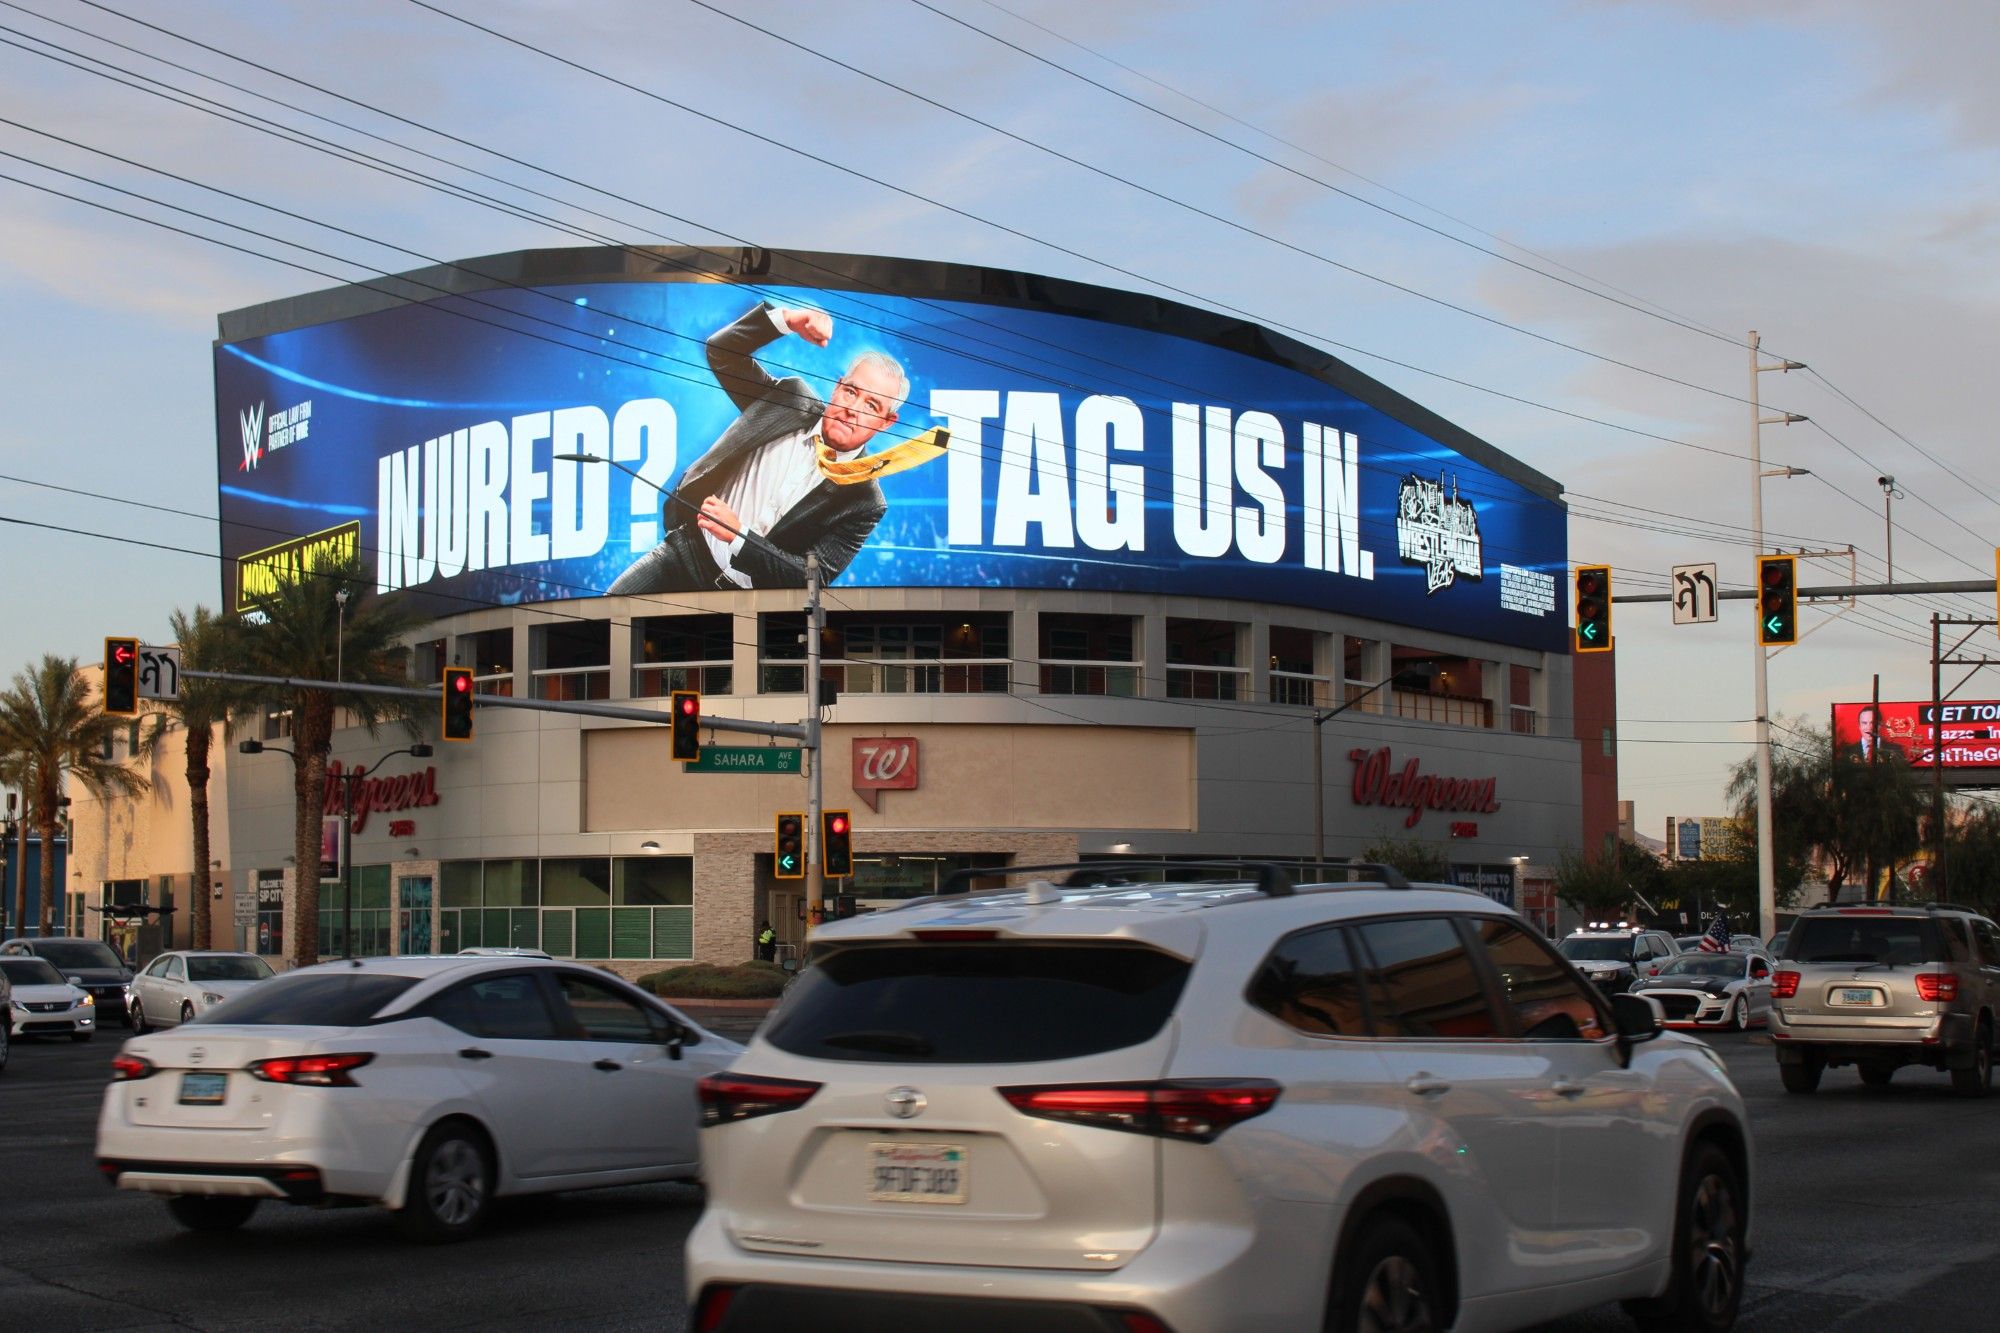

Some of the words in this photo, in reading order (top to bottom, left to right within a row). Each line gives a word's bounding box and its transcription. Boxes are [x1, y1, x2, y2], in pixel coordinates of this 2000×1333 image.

[378, 397, 678, 595] INJURED?
[929, 390, 1146, 552] TAG
[1171, 401, 1286, 564] US
[1302, 421, 1374, 581] IN.
[242, 551, 289, 602] MORGAN
[291, 548, 300, 586] &
[714, 753, 765, 766] SAHARA
[778, 751, 793, 760] AVE
[1348, 745, 1501, 829] Walgreens
[259, 889, 270, 903] SIP
[1458, 872, 1498, 885] WELCOME
[1498, 873, 1510, 886] TO
